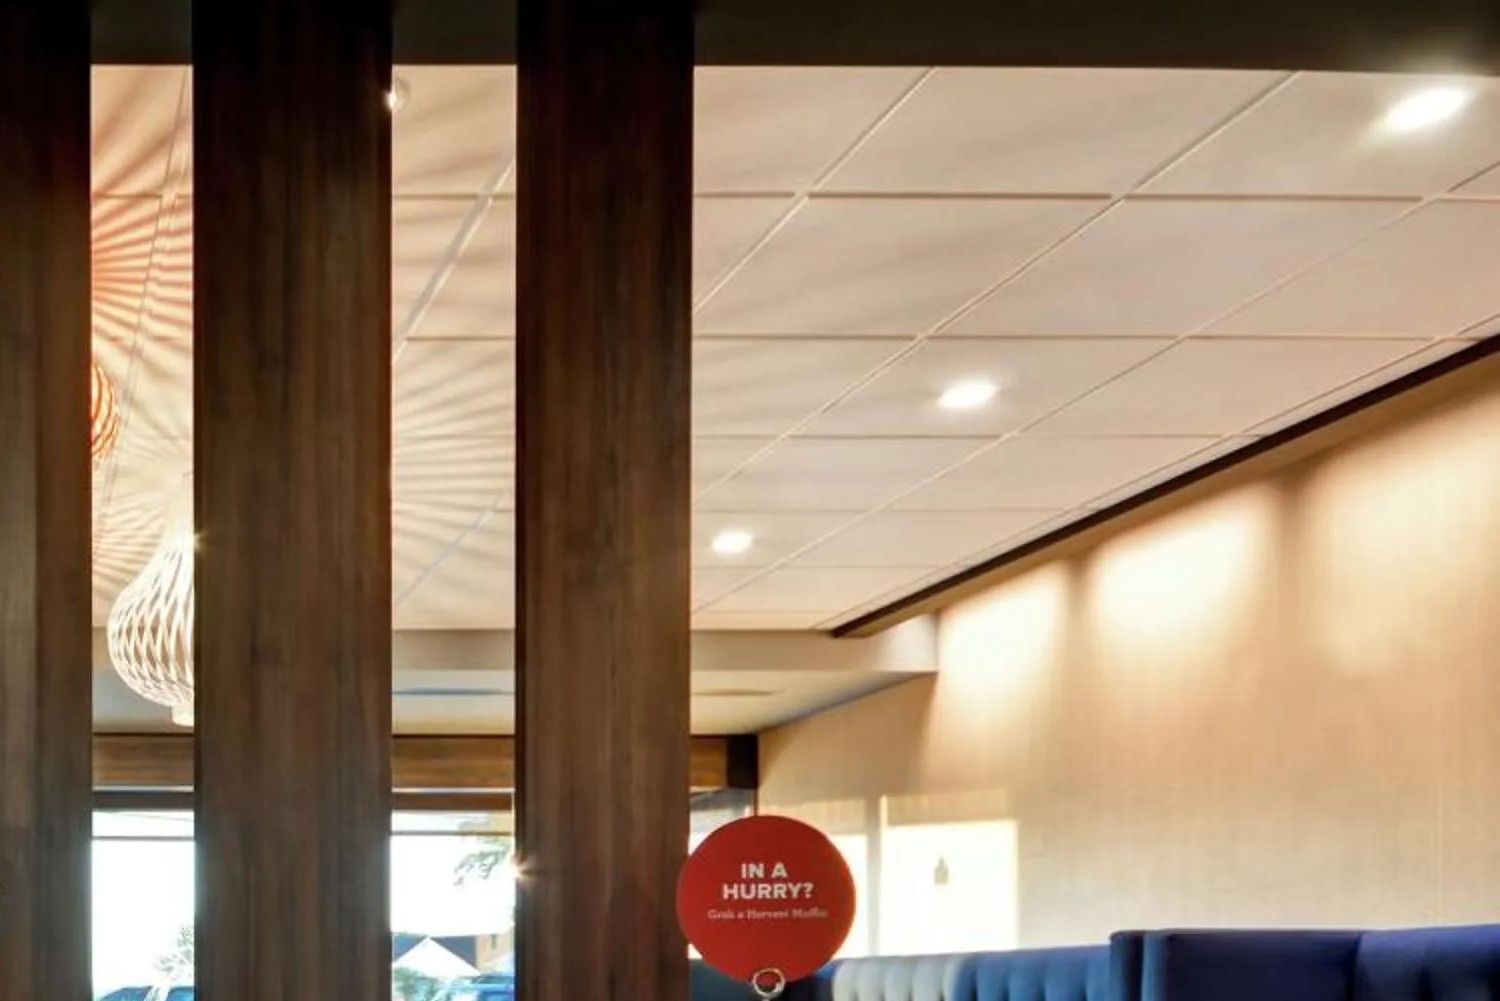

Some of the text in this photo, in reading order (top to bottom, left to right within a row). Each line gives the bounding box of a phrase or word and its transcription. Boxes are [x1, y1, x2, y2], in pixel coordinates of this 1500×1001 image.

[741, 863, 788, 878] IN A
[723, 883, 814, 899] HURRY?
